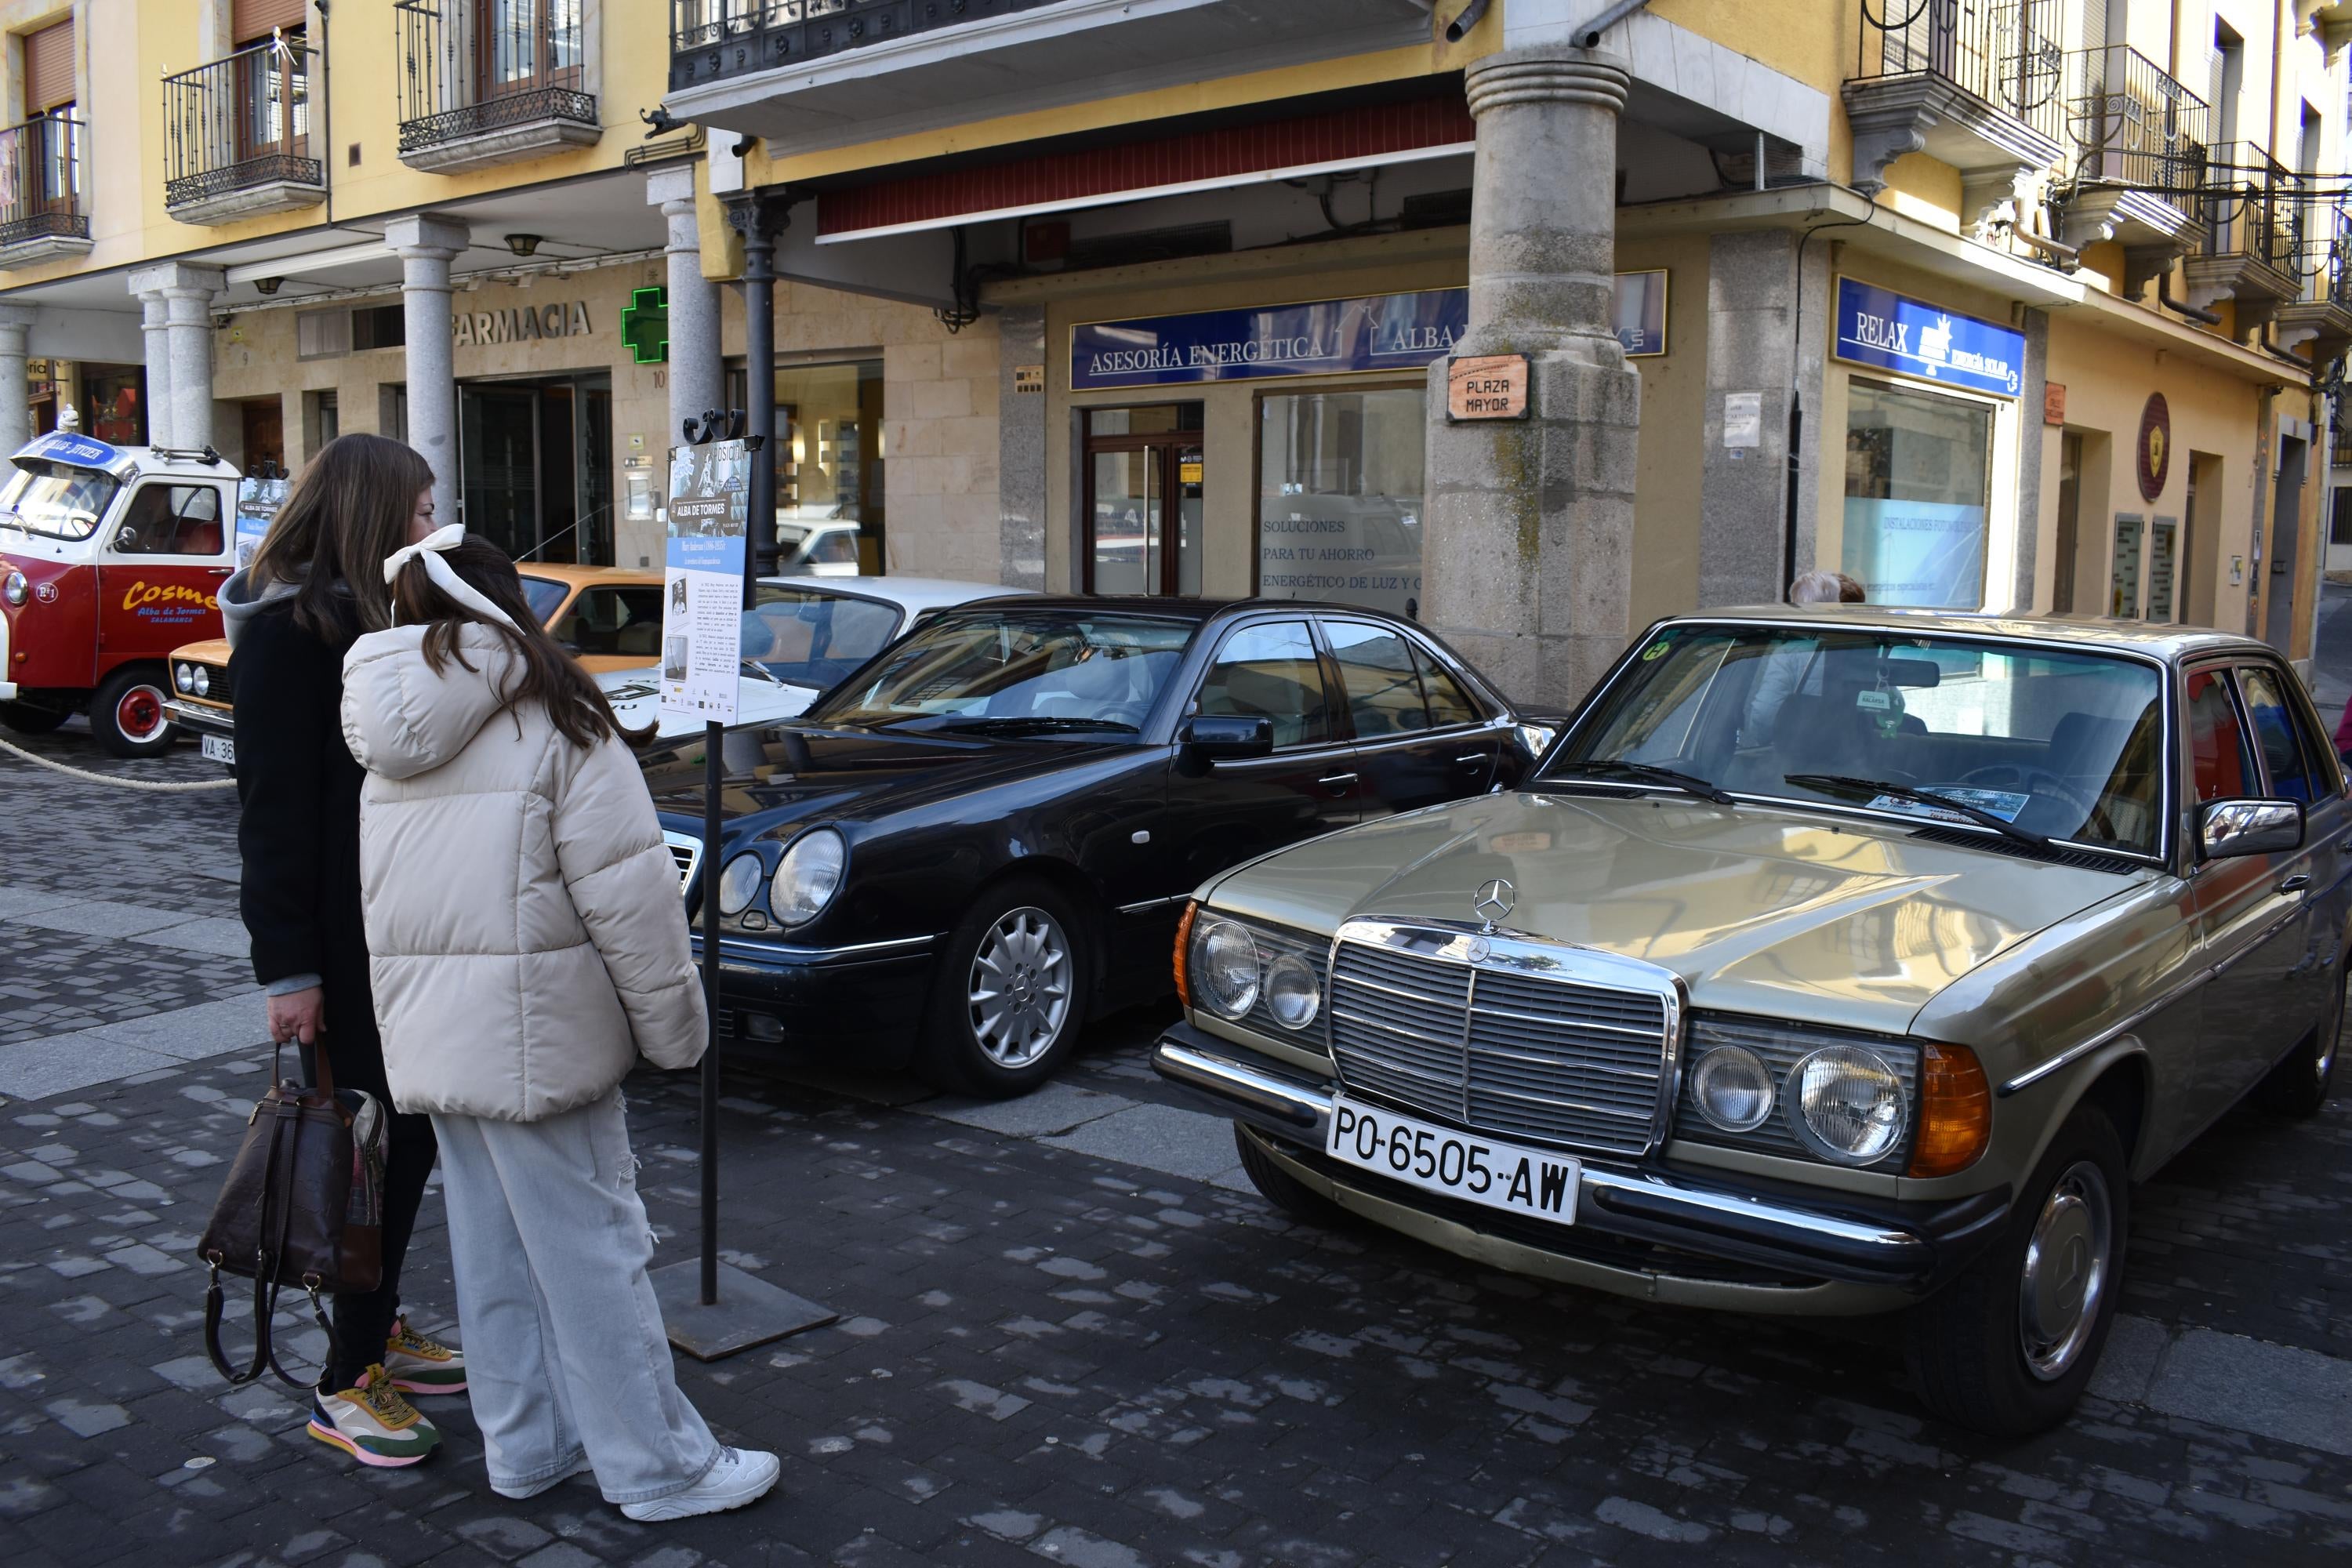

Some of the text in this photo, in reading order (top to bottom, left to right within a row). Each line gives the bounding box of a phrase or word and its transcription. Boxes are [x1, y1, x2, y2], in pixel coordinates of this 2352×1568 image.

[1856, 312, 1908, 353] RELAX
[1089, 325, 1454, 373] ASESORÍA ENERGÉTICA ALBA
[26, 361, 46, 374] ría
[653, 370, 665, 389] 10
[1467, 379, 1509, 394] PLAZA
[1466, 397, 1508, 412] MAYOR
[677, 503, 725, 517] ALBA DE TORMES
[1264, 521, 1345, 533] SOLUCIONES
[1263, 548, 1374, 561] PARA TU AHORRO
[1263, 574, 1345, 588] ENERGÉTICO
[1349, 577, 1368, 589] DE
[1372, 578, 1397, 589] LUZ
[1402, 578, 1410, 589] Y
[123, 581, 219, 610] Cosme
[138, 607, 161, 616] Alba
[1334, 1105, 1569, 1213] PO-6505-AW
